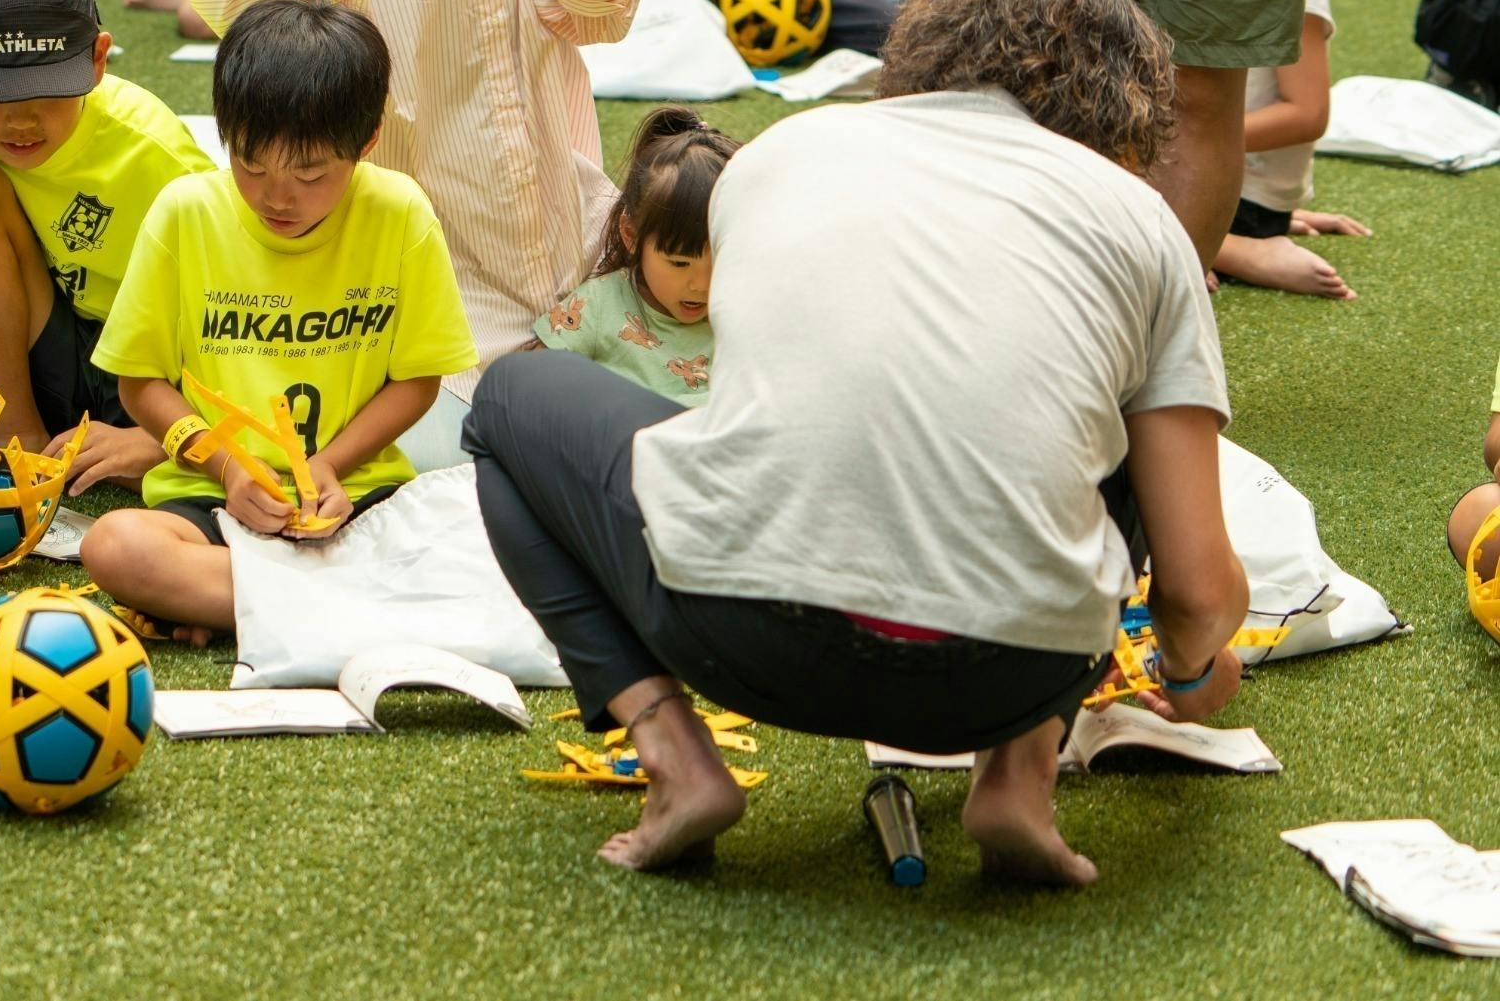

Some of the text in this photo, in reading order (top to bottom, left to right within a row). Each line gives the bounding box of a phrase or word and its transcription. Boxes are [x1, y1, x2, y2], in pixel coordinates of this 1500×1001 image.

[233, 344, 254, 356] 1983
[258, 346, 279, 357] 1985
[283, 347, 306, 358] 1986
[311, 346, 331, 357] 1987
